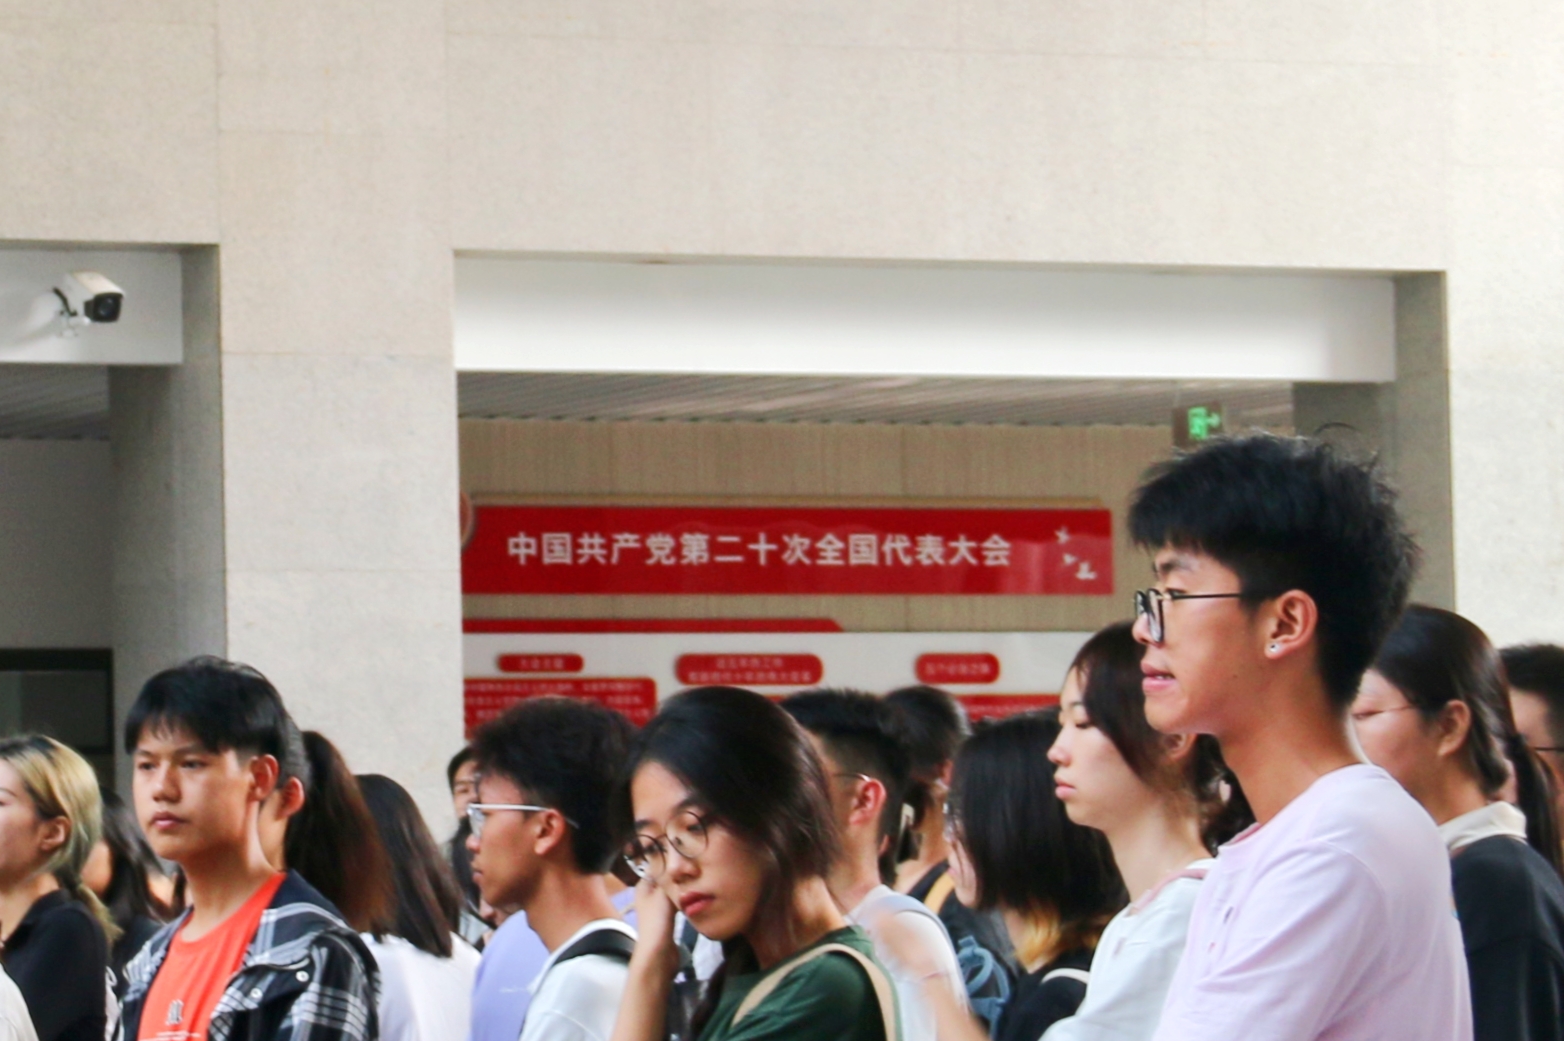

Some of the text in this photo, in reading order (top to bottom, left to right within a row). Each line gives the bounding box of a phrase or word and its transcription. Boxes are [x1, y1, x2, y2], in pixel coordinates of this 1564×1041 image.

[507, 532, 1012, 565] 中国共产党第二十次全国代表大会
